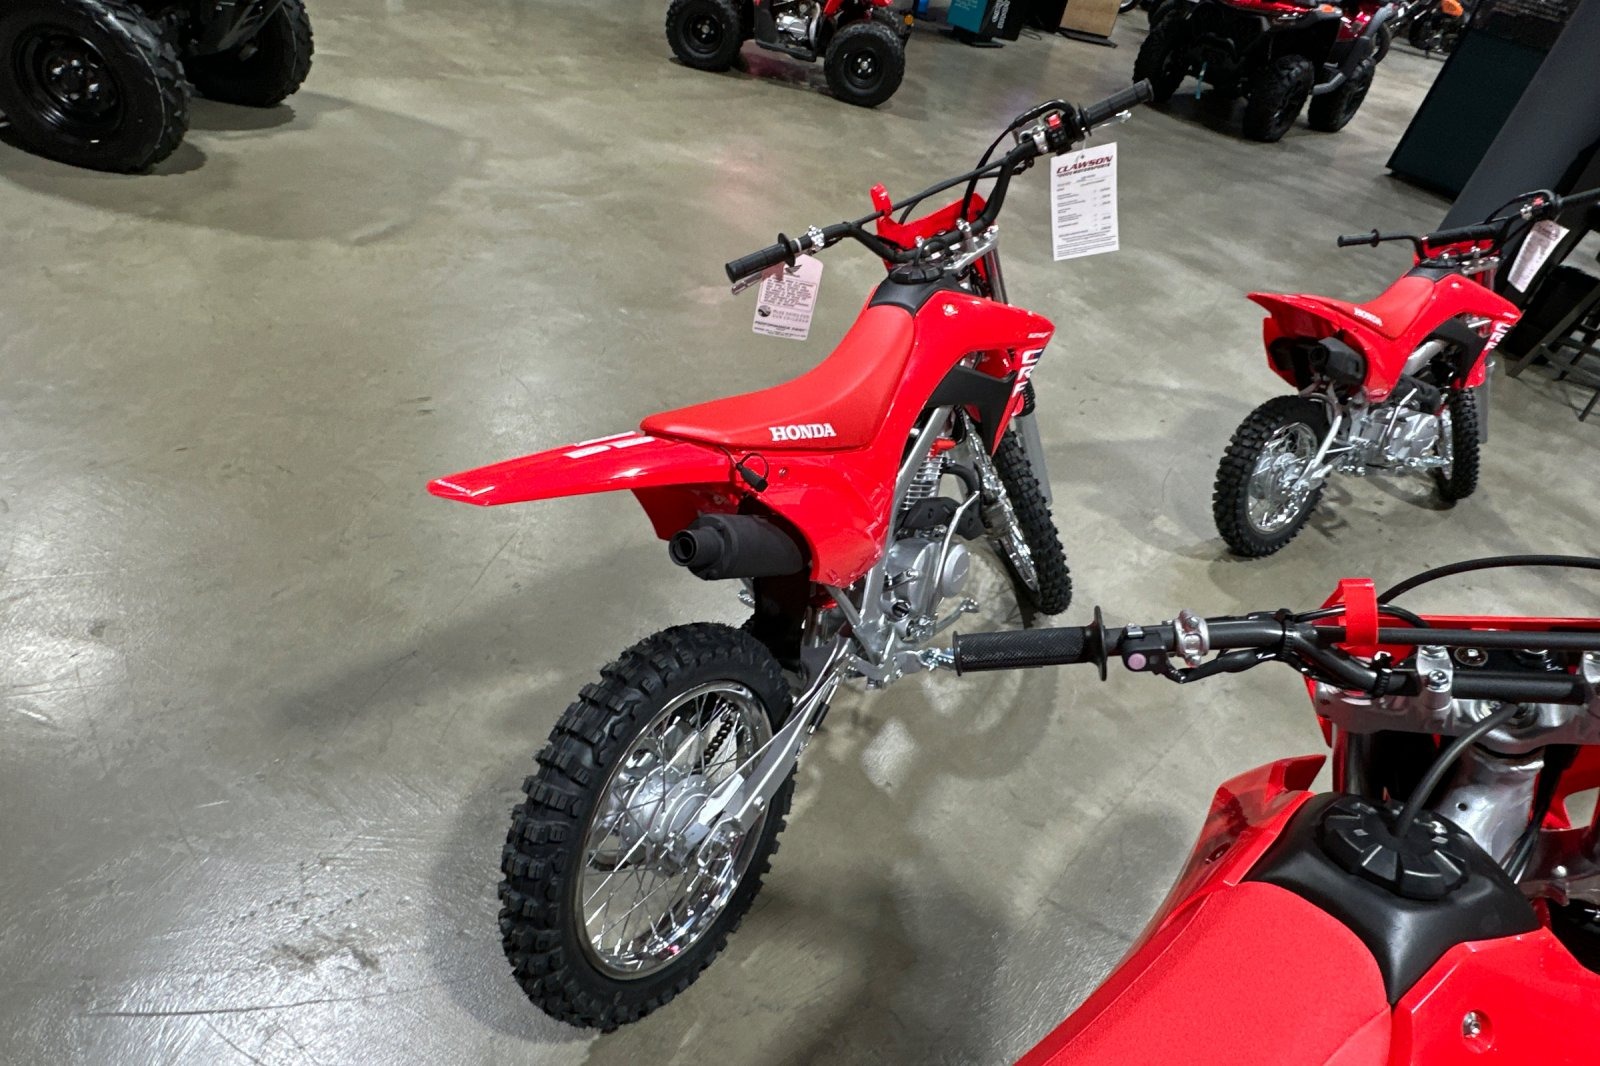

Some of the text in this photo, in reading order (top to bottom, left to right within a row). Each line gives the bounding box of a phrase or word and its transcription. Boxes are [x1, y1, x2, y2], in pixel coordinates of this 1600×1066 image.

[1056, 155, 1113, 174] CLAWSON
[1012, 348, 1043, 398] CRF
[768, 422, 837, 442] HONDA
